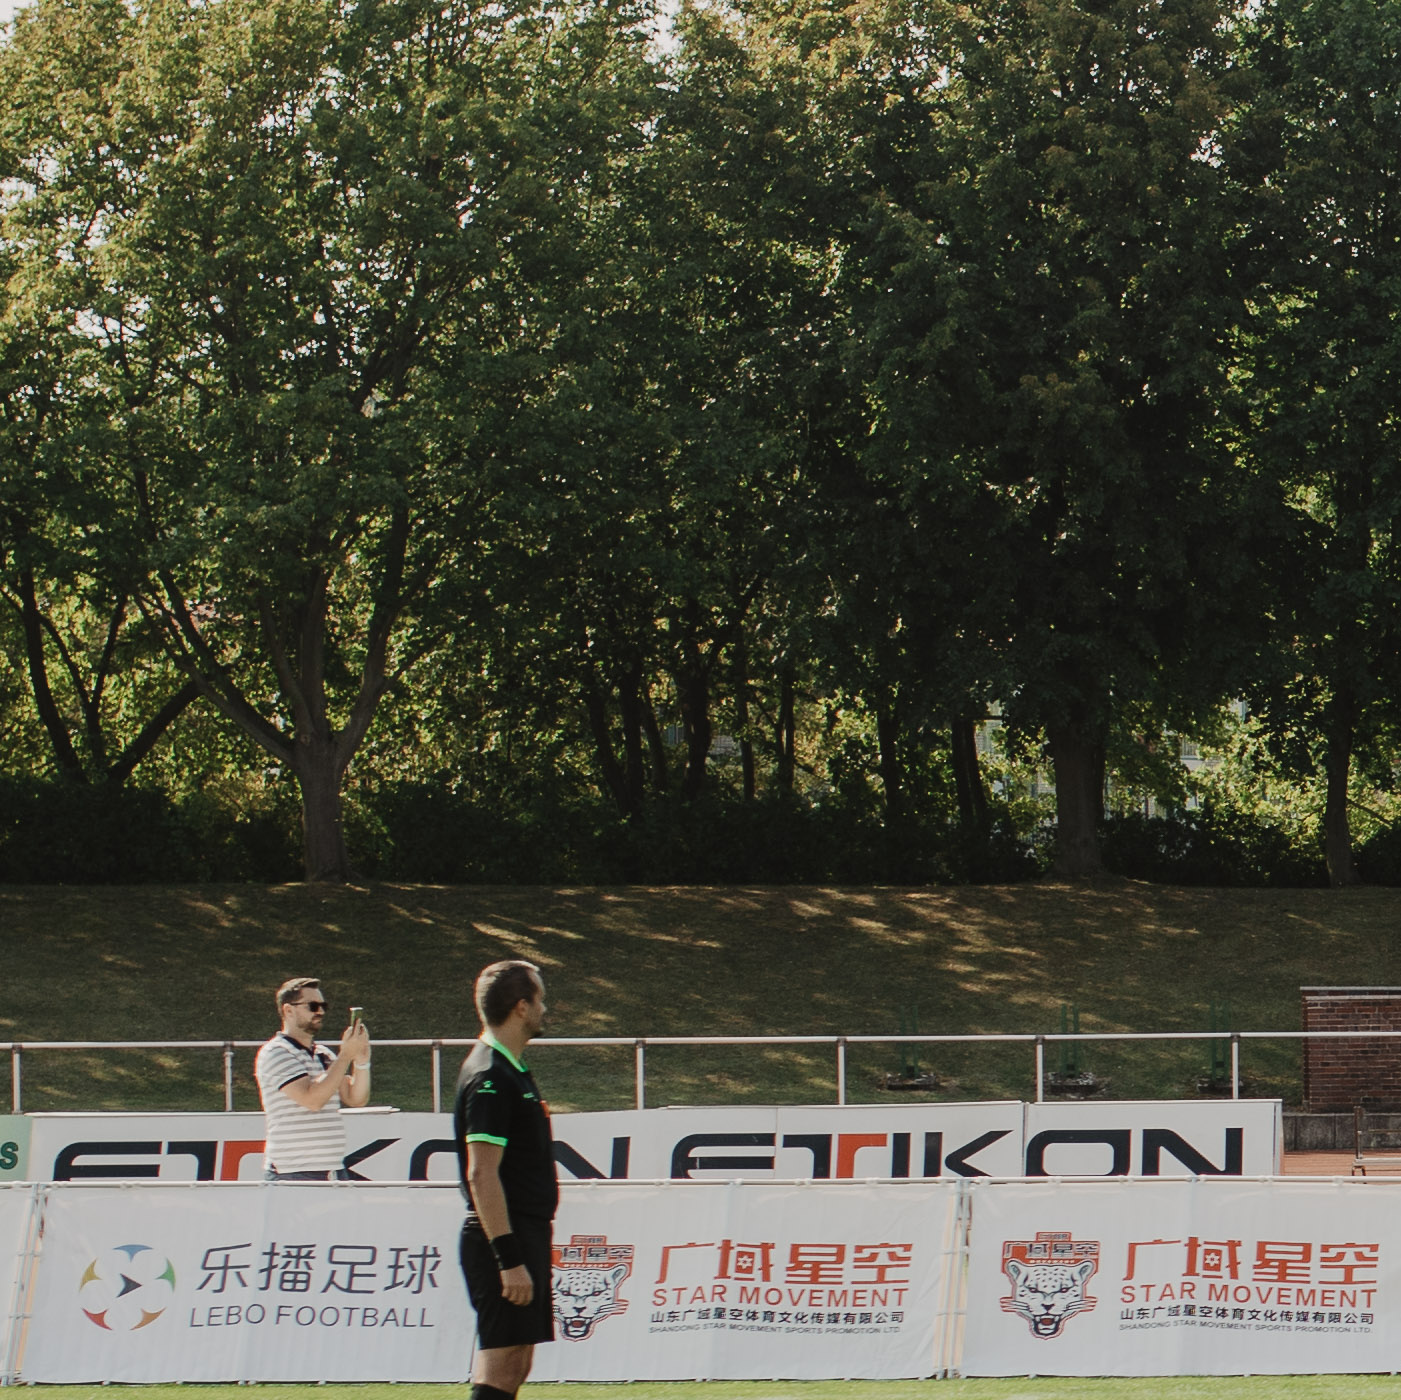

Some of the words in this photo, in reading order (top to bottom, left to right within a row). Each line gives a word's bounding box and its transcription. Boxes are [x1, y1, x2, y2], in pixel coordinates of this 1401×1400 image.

[196, 1242, 442, 1294] 乐播足球
[655, 1239, 913, 1285] 广域星空
[1122, 1236, 1379, 1285] 广域星空
[652, 1284, 728, 1306] STAR
[739, 1286, 909, 1307] MOVEMENT
[1120, 1281, 1197, 1303] STAR
[1208, 1283, 1378, 1308] MOVEMENT
[189, 1304, 266, 1327] LEBO
[275, 1305, 435, 1327] FOOTBALL
[703, 1322, 727, 1330] STAR
[730, 1324, 782, 1333] MOVEMENT
[785, 1326, 823, 1334] SPORTS
[1119, 1320, 1171, 1331] SHANDONG
[1173, 1319, 1197, 1327] STAR
[1200, 1321, 1252, 1331] MOVEMENT
[1255, 1323, 1292, 1332] SPORTS
[1295, 1325, 1351, 1333] PROMOTION
